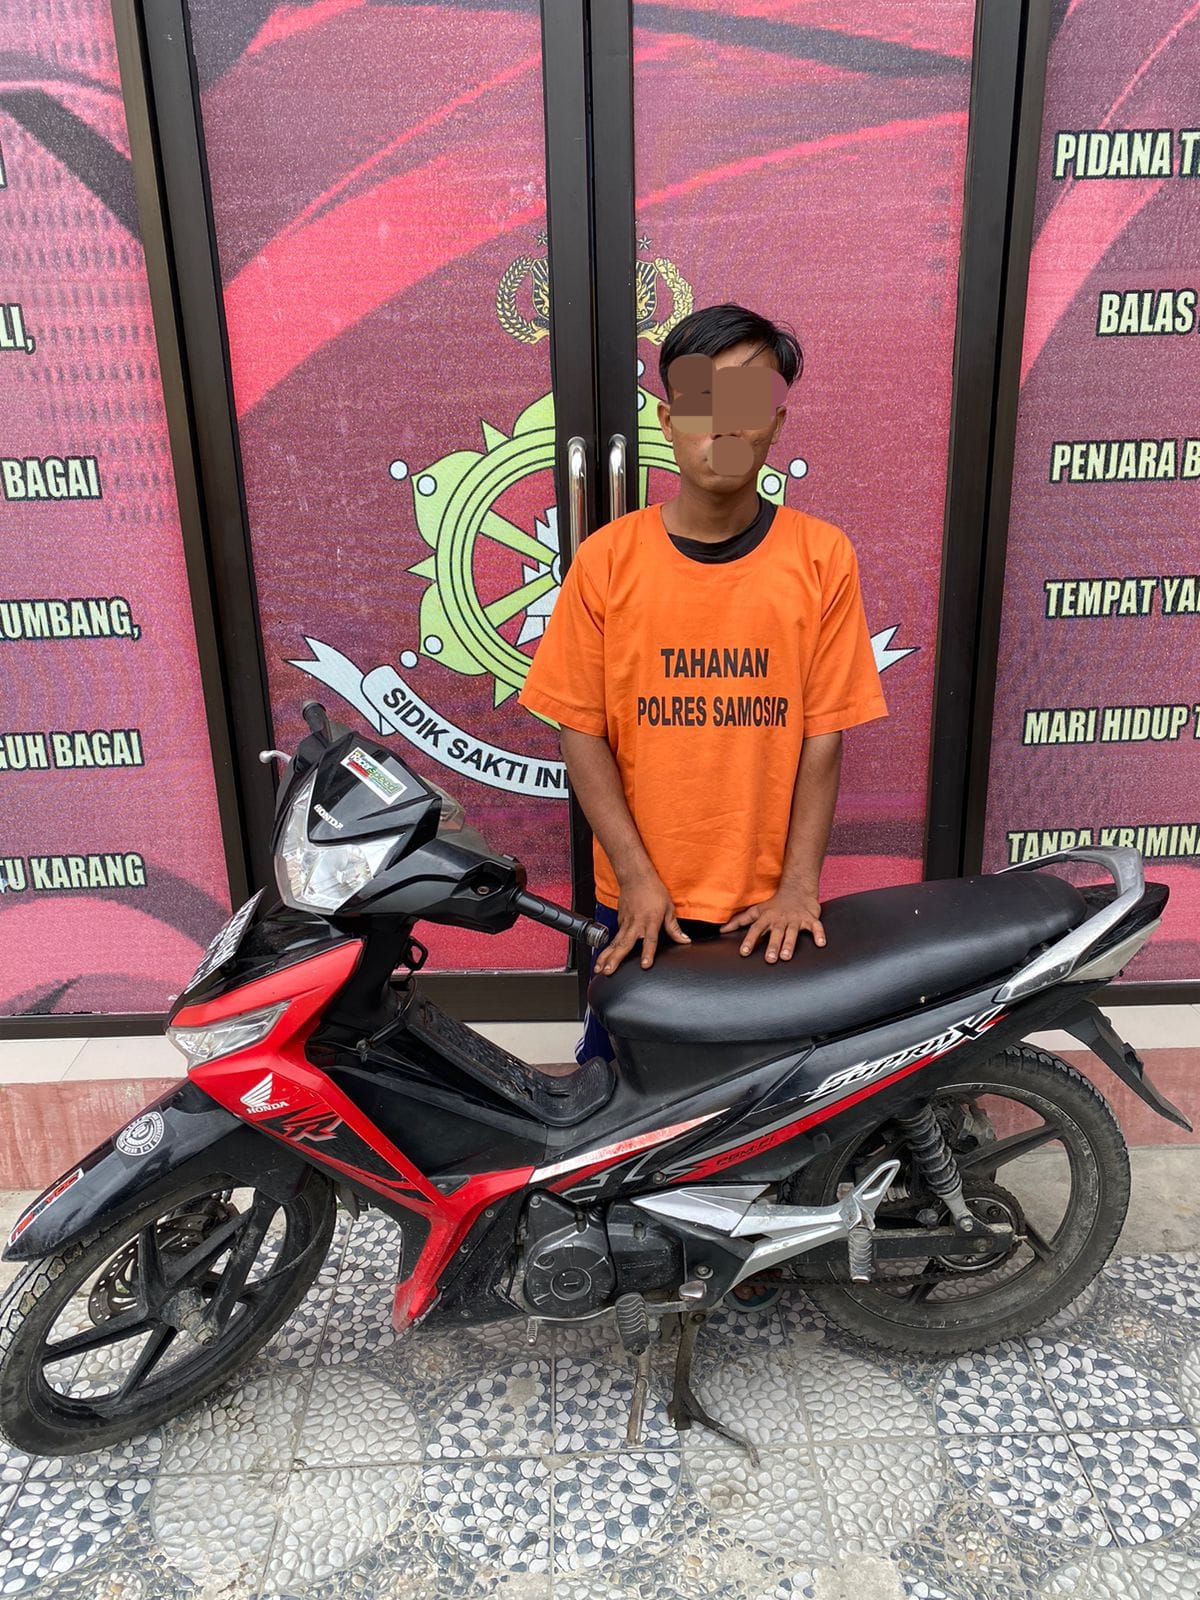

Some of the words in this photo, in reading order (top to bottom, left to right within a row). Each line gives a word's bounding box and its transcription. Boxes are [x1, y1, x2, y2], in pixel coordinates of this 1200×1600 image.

[1055, 129, 1173, 178] PIDANA
[1180, 129, 1200, 177] T
[1097, 288, 1197, 336] BALAS
[1, 456, 101, 500] BAGAI
[1050, 438, 1177, 482] PENJARA
[1045, 577, 1158, 618] TEMPAT
[1162, 576, 1200, 614] YA
[0, 598, 141, 640] UMBANG,
[661, 648, 769, 678] TAHANAN
[638, 696, 706, 726] POLRES
[713, 696, 788, 727] SAMOSIR
[1023, 708, 1098, 745] MARI
[1100, 704, 1189, 742] HIDUP
[51, 729, 144, 768] BAGAI
[383, 687, 449, 747] SIDIK
[447, 738, 529, 784] SAKTI
[1099, 823, 1200, 858] KRIMIN
[29, 852, 147, 890] KARANG
[246, 1101, 290, 1114] HONDA
